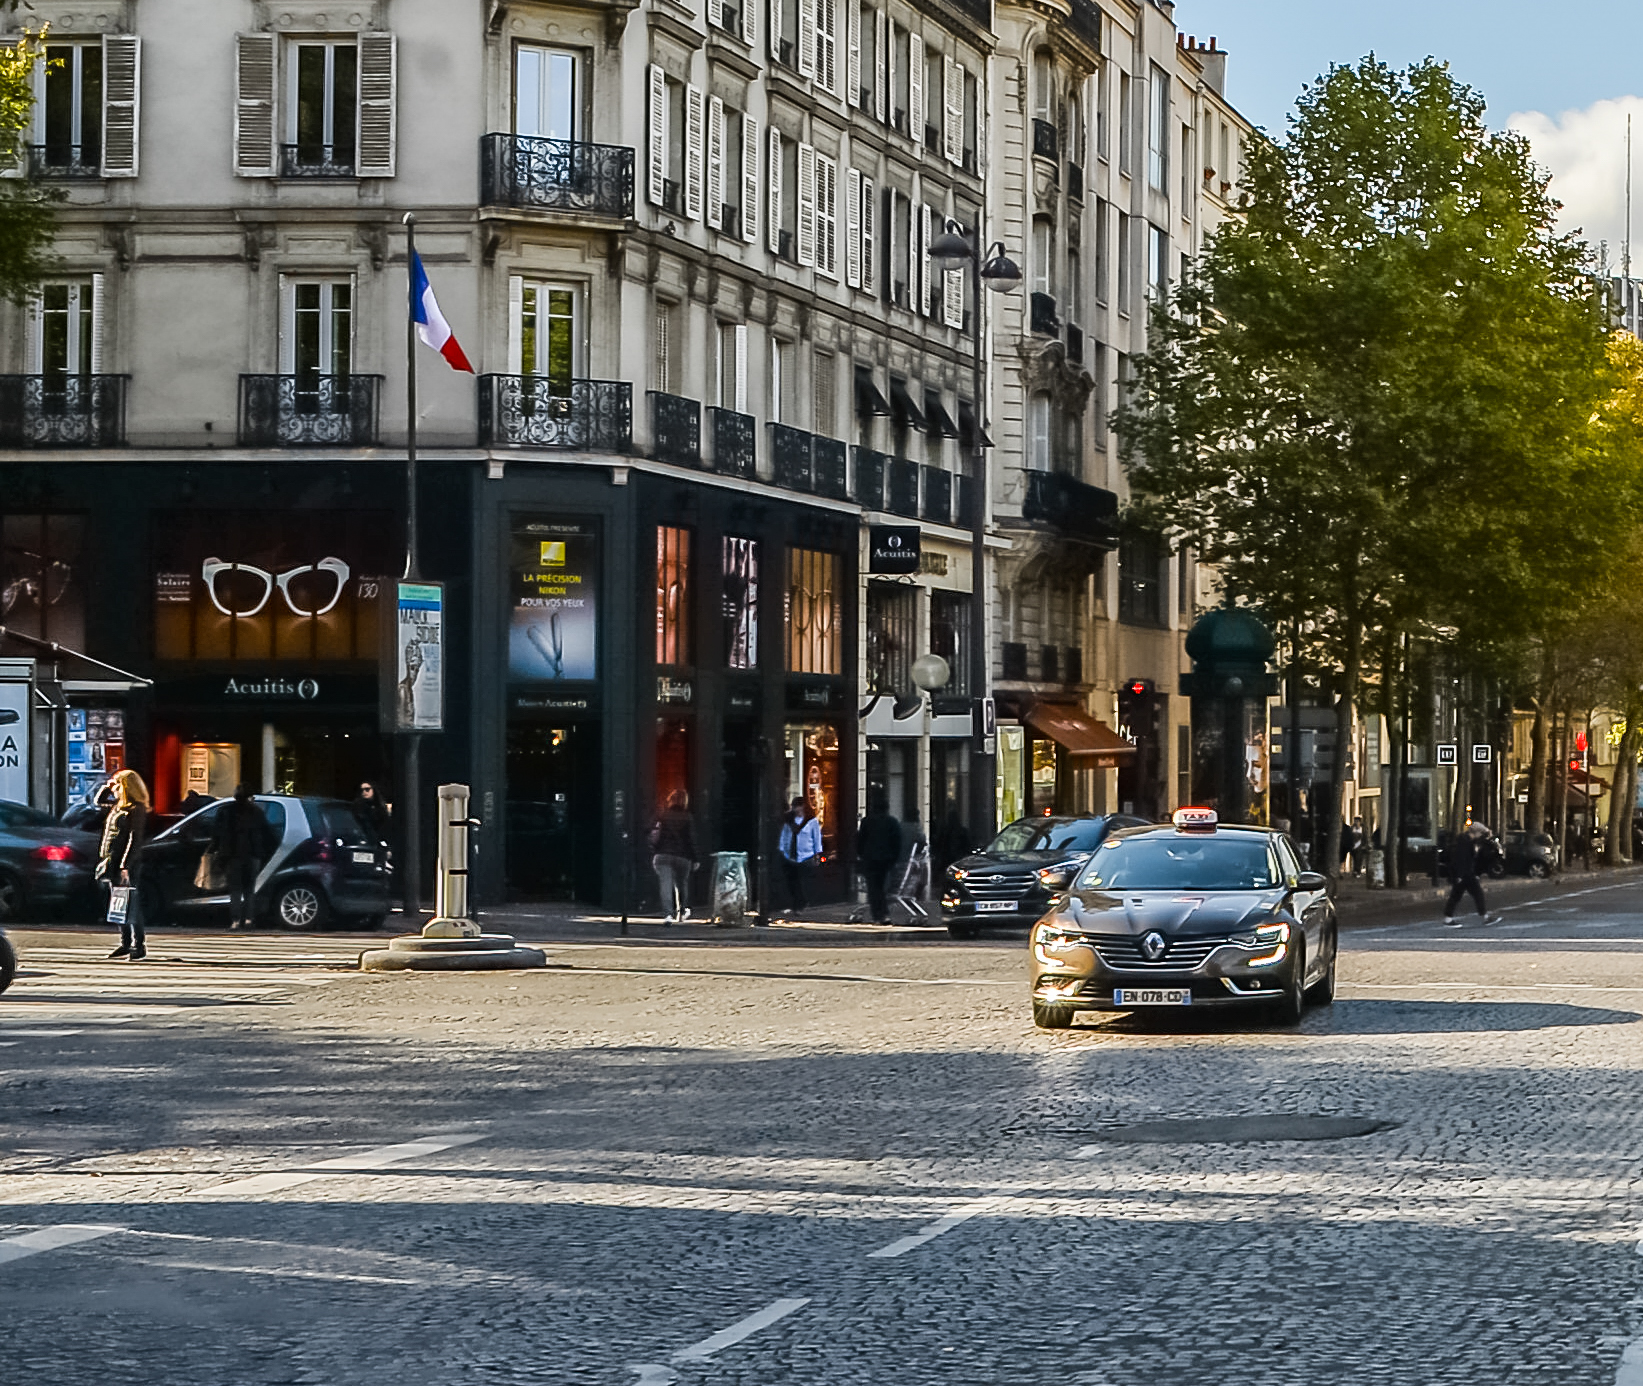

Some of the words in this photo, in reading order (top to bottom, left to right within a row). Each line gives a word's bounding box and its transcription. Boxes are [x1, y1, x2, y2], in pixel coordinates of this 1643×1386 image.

[873, 547, 917, 558] Acuitis
[523, 574, 534, 583] LA
[539, 586, 567, 595] NIKON
[521, 597, 543, 607] POUR
[545, 598, 561, 607] VOS
[563, 599, 585, 608] YEUX
[224, 678, 294, 694] Acuitis
